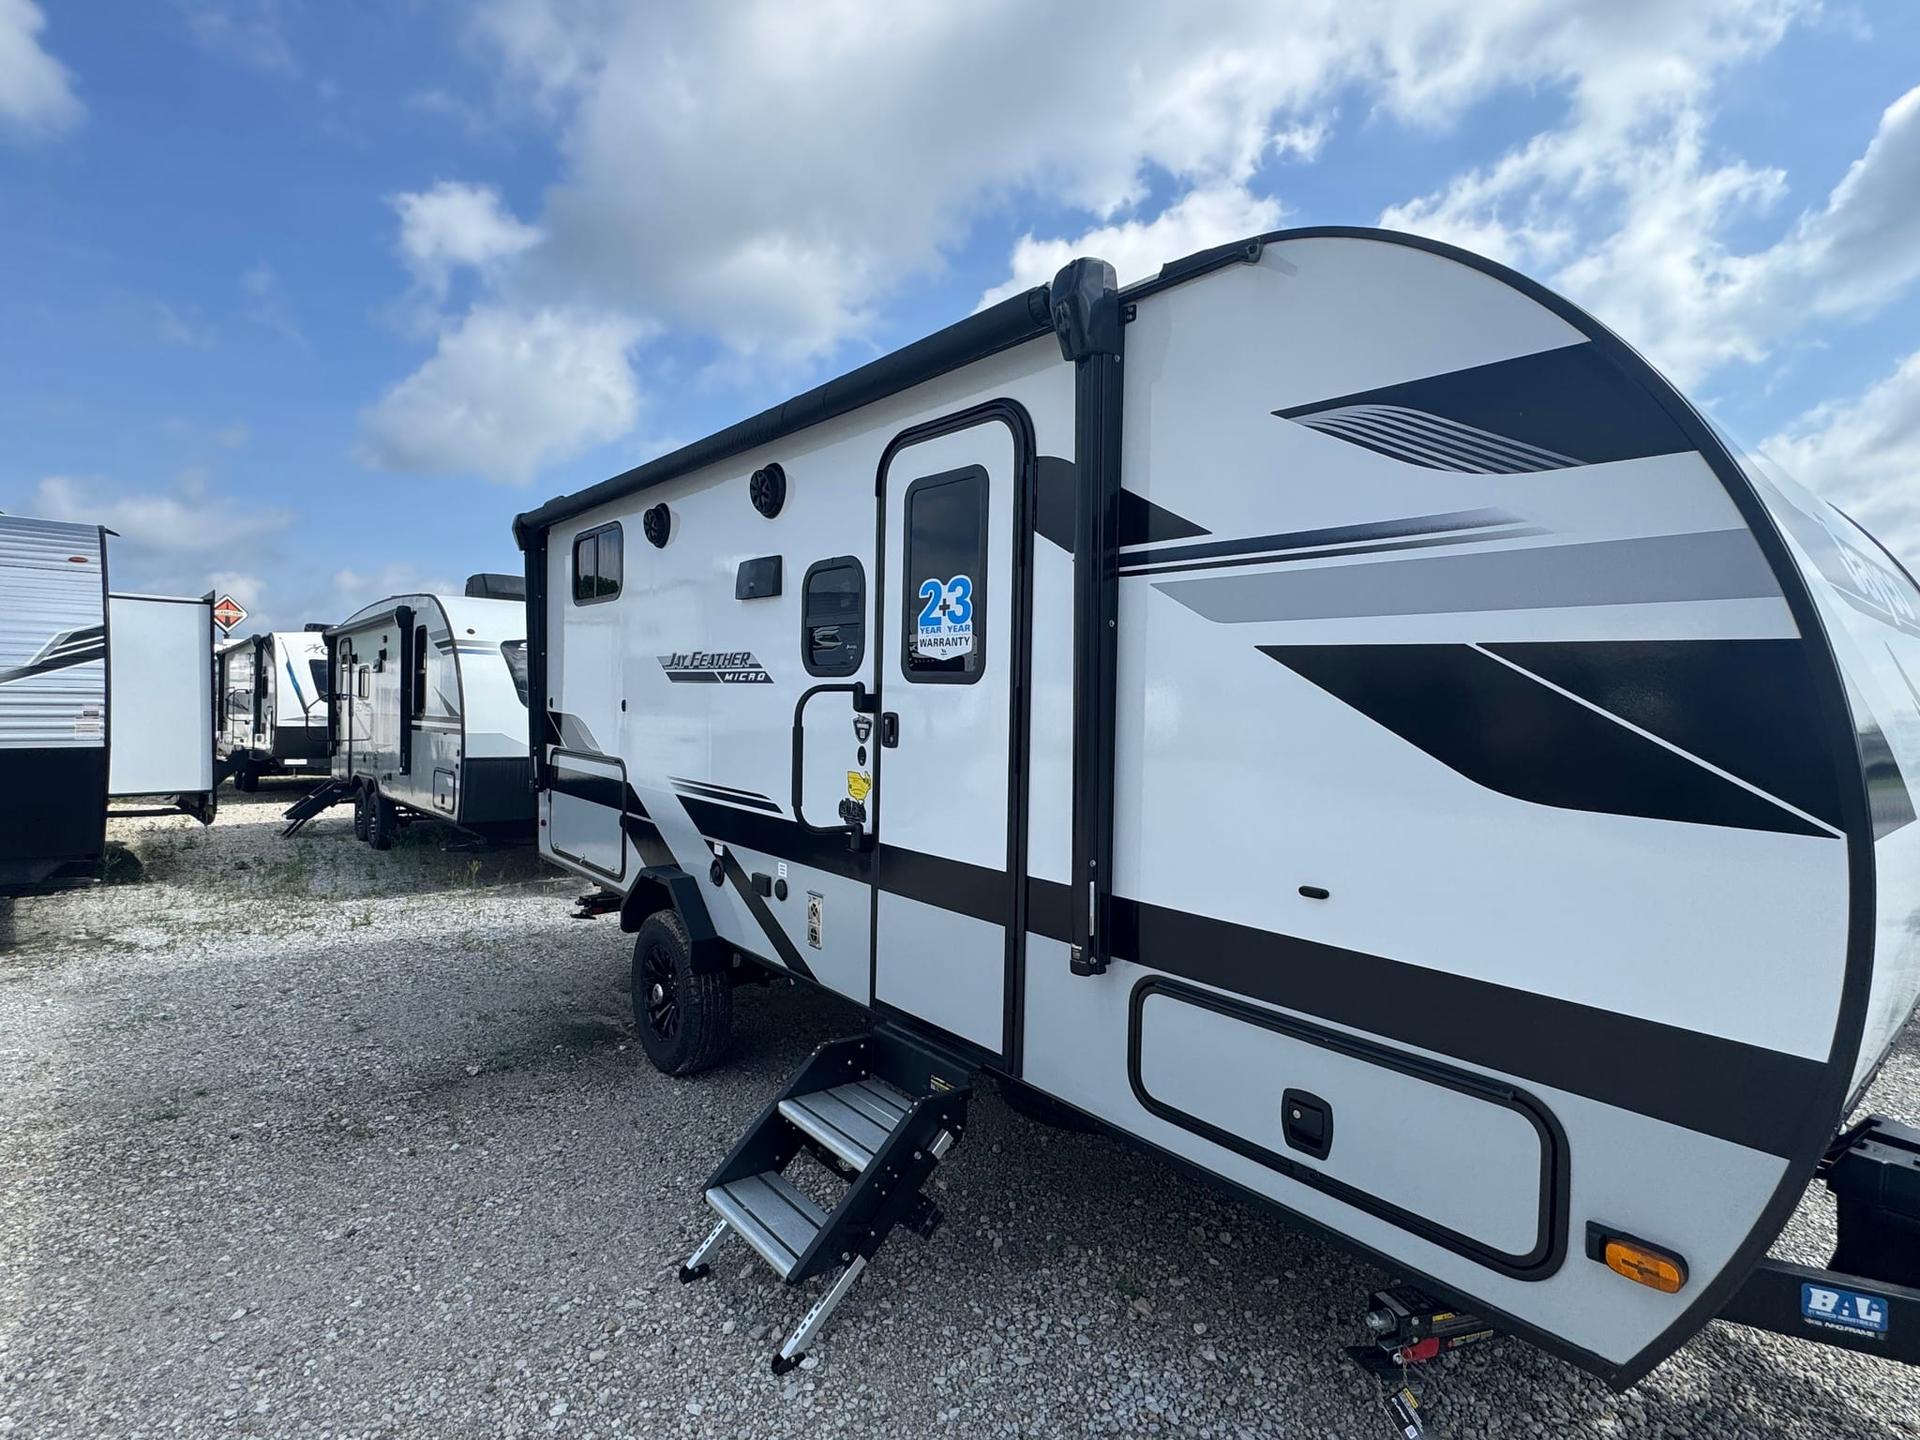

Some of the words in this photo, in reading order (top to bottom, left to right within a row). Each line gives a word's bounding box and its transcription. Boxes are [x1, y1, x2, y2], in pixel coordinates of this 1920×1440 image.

[920, 626, 942, 635] YEAR
[947, 624, 971, 633] YEAR
[919, 636, 971, 648] WARRANTY
[690, 651, 751, 668] FEATHER
[723, 672, 766, 681] MICRO
